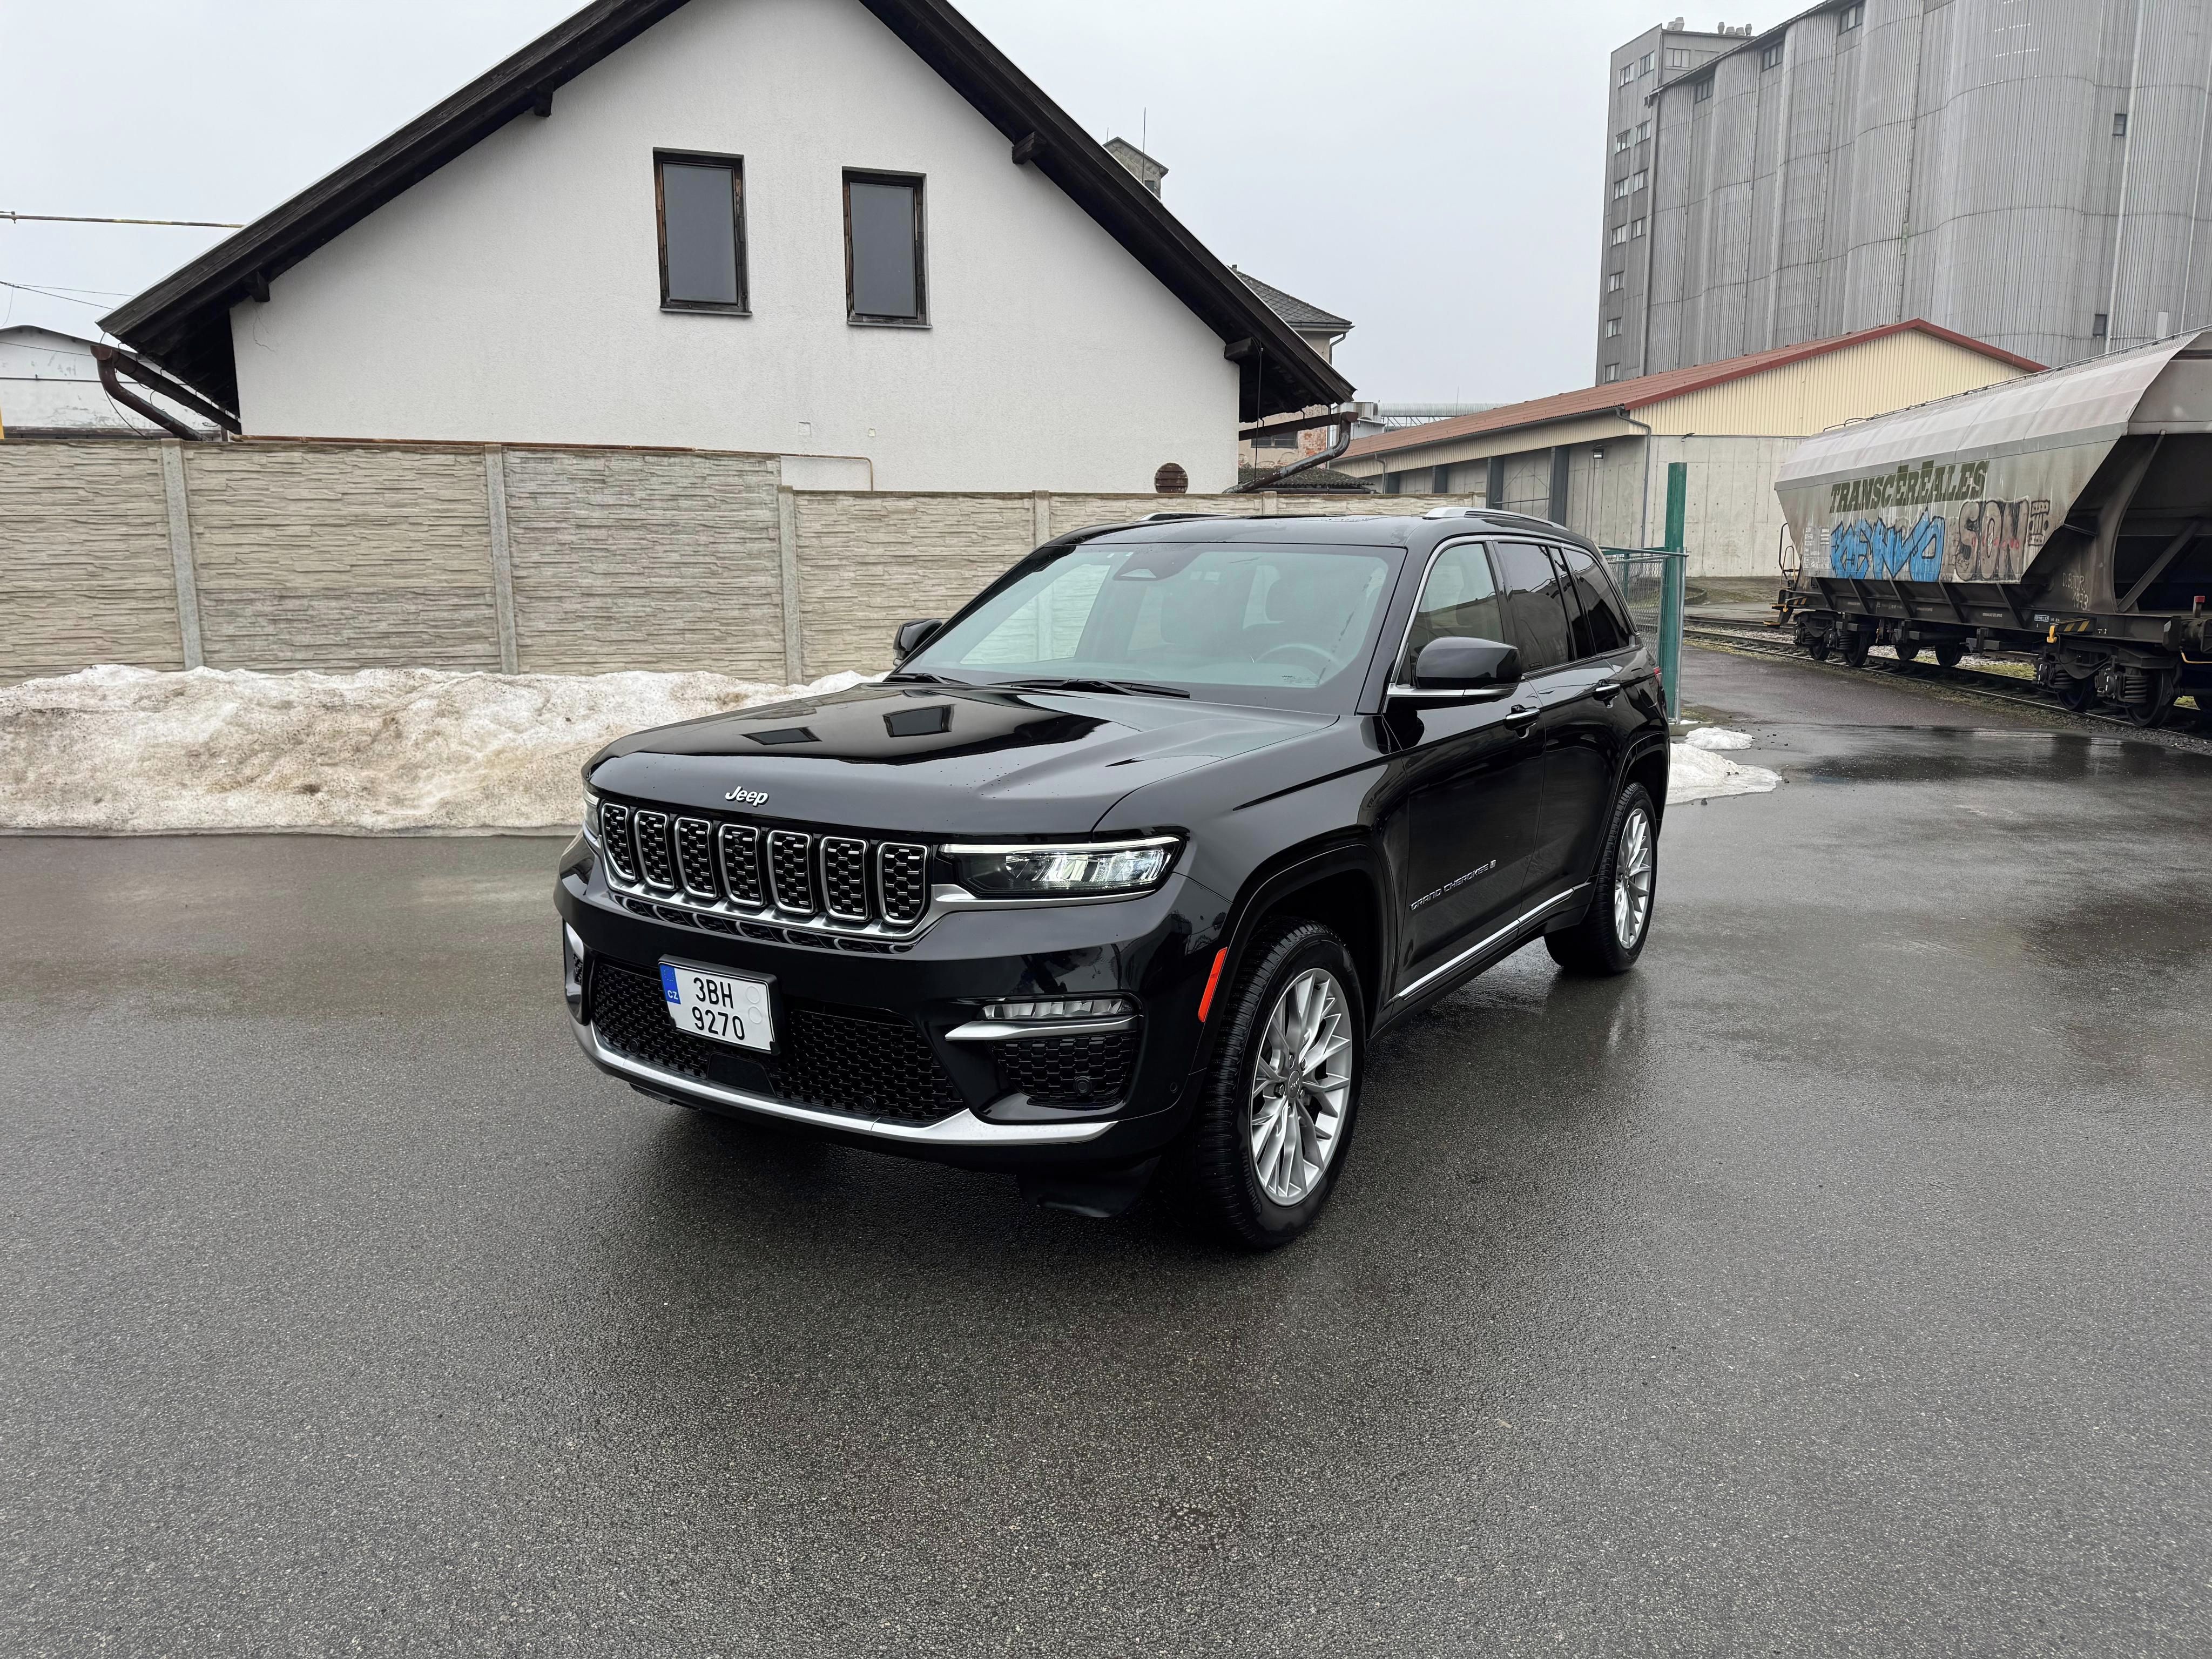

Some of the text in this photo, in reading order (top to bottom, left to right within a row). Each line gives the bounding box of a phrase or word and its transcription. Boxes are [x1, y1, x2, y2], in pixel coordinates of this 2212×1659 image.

[725, 786, 769, 807] Jeep
[1410, 864, 1489, 911] GRAND CHEROKEE
[667, 989, 679, 1000] CZ
[693, 977, 734, 1009] 3BH
[692, 1006, 745, 1040] 9270
